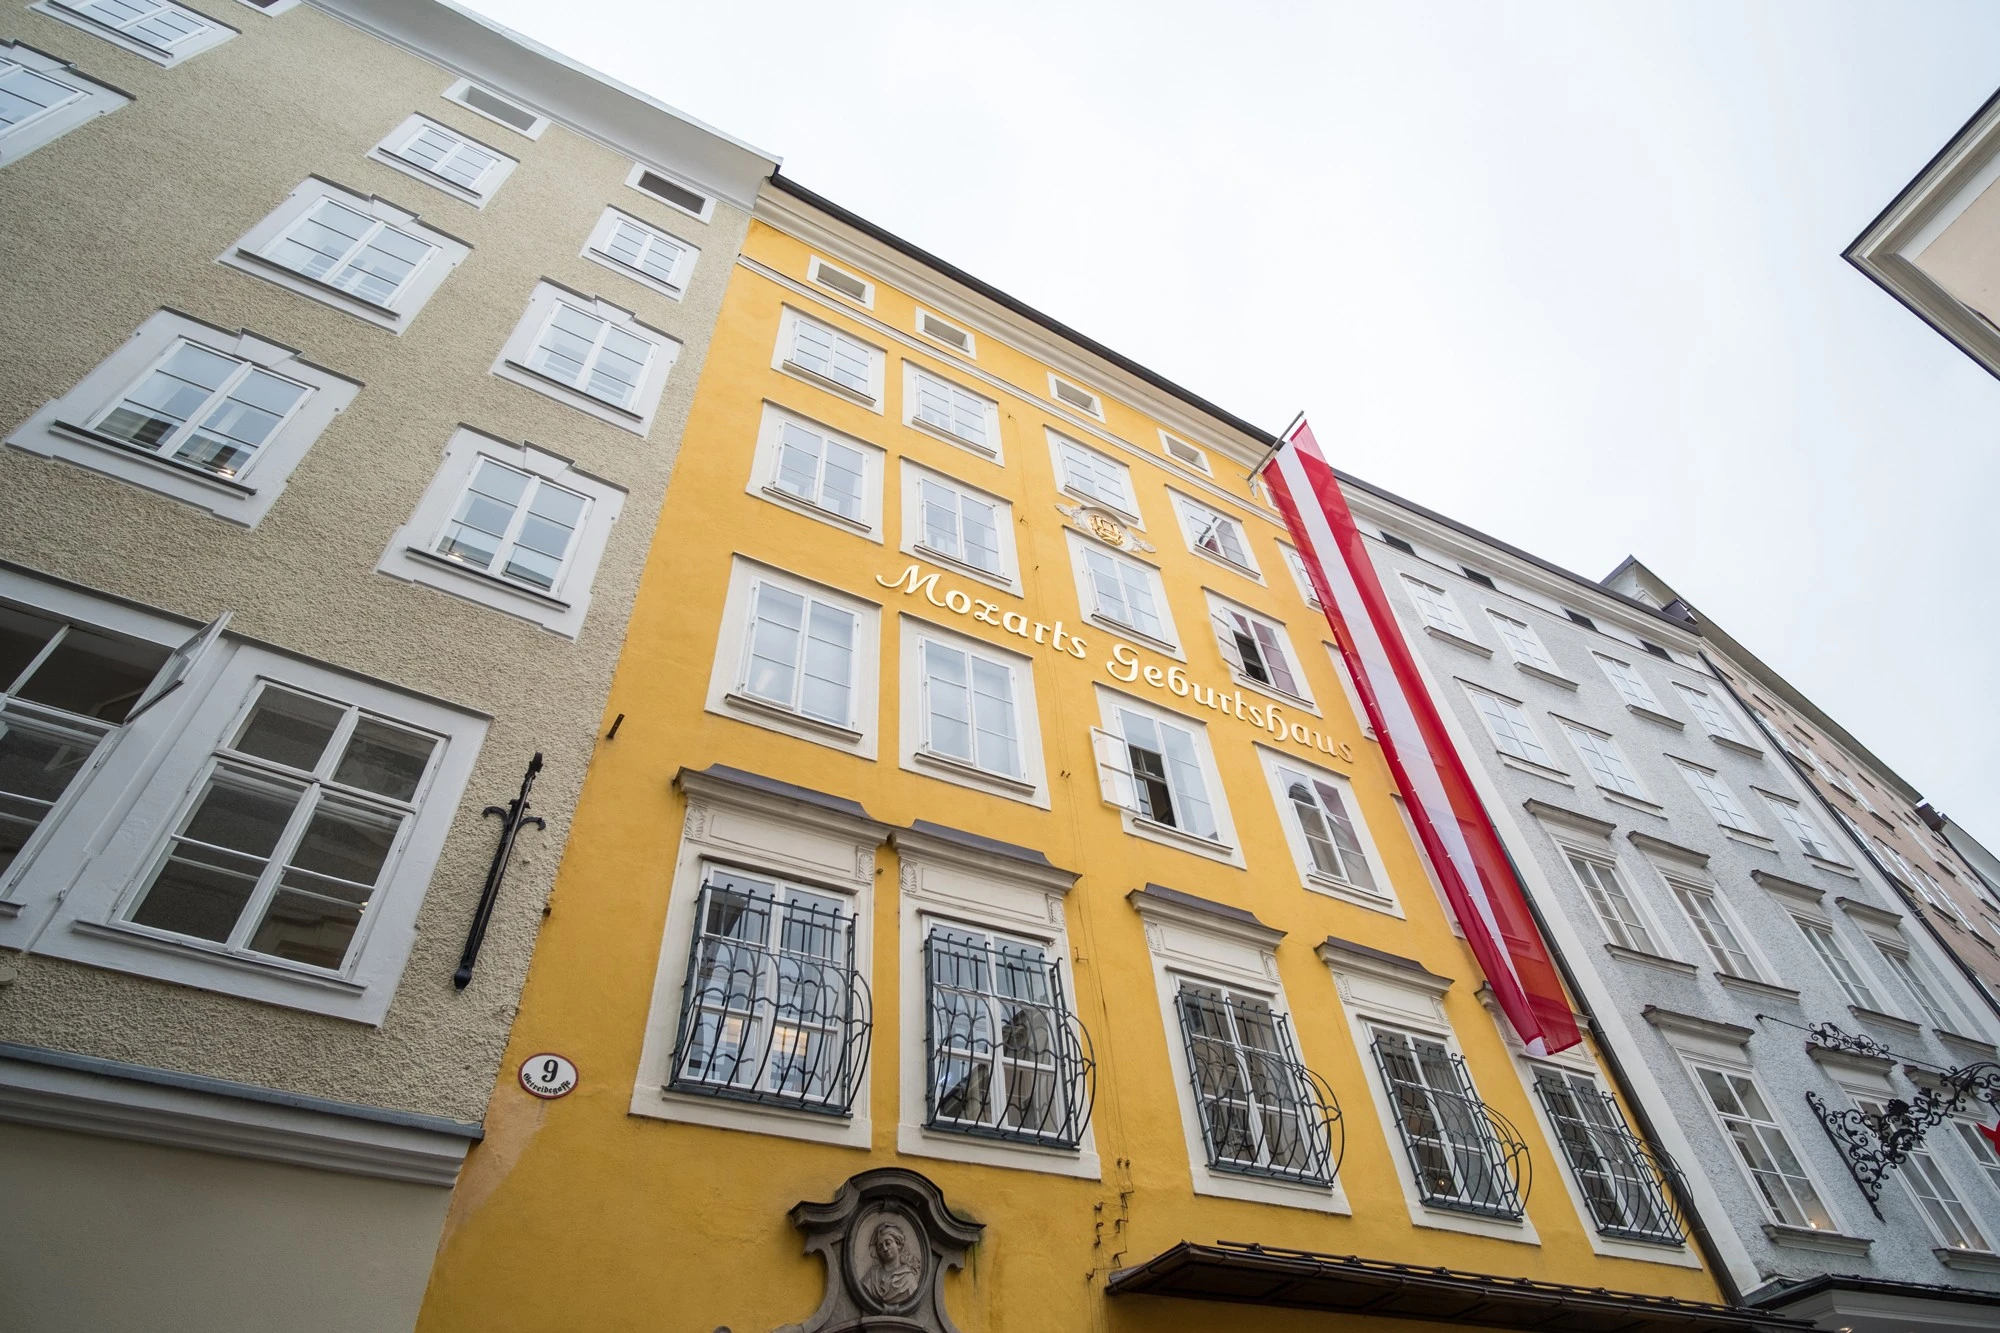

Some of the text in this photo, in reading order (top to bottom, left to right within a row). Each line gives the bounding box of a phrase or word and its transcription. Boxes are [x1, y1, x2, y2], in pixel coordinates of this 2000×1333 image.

[875, 564, 1354, 763] Mozarts Geburtshaus
[541, 1059, 559, 1083] 9
